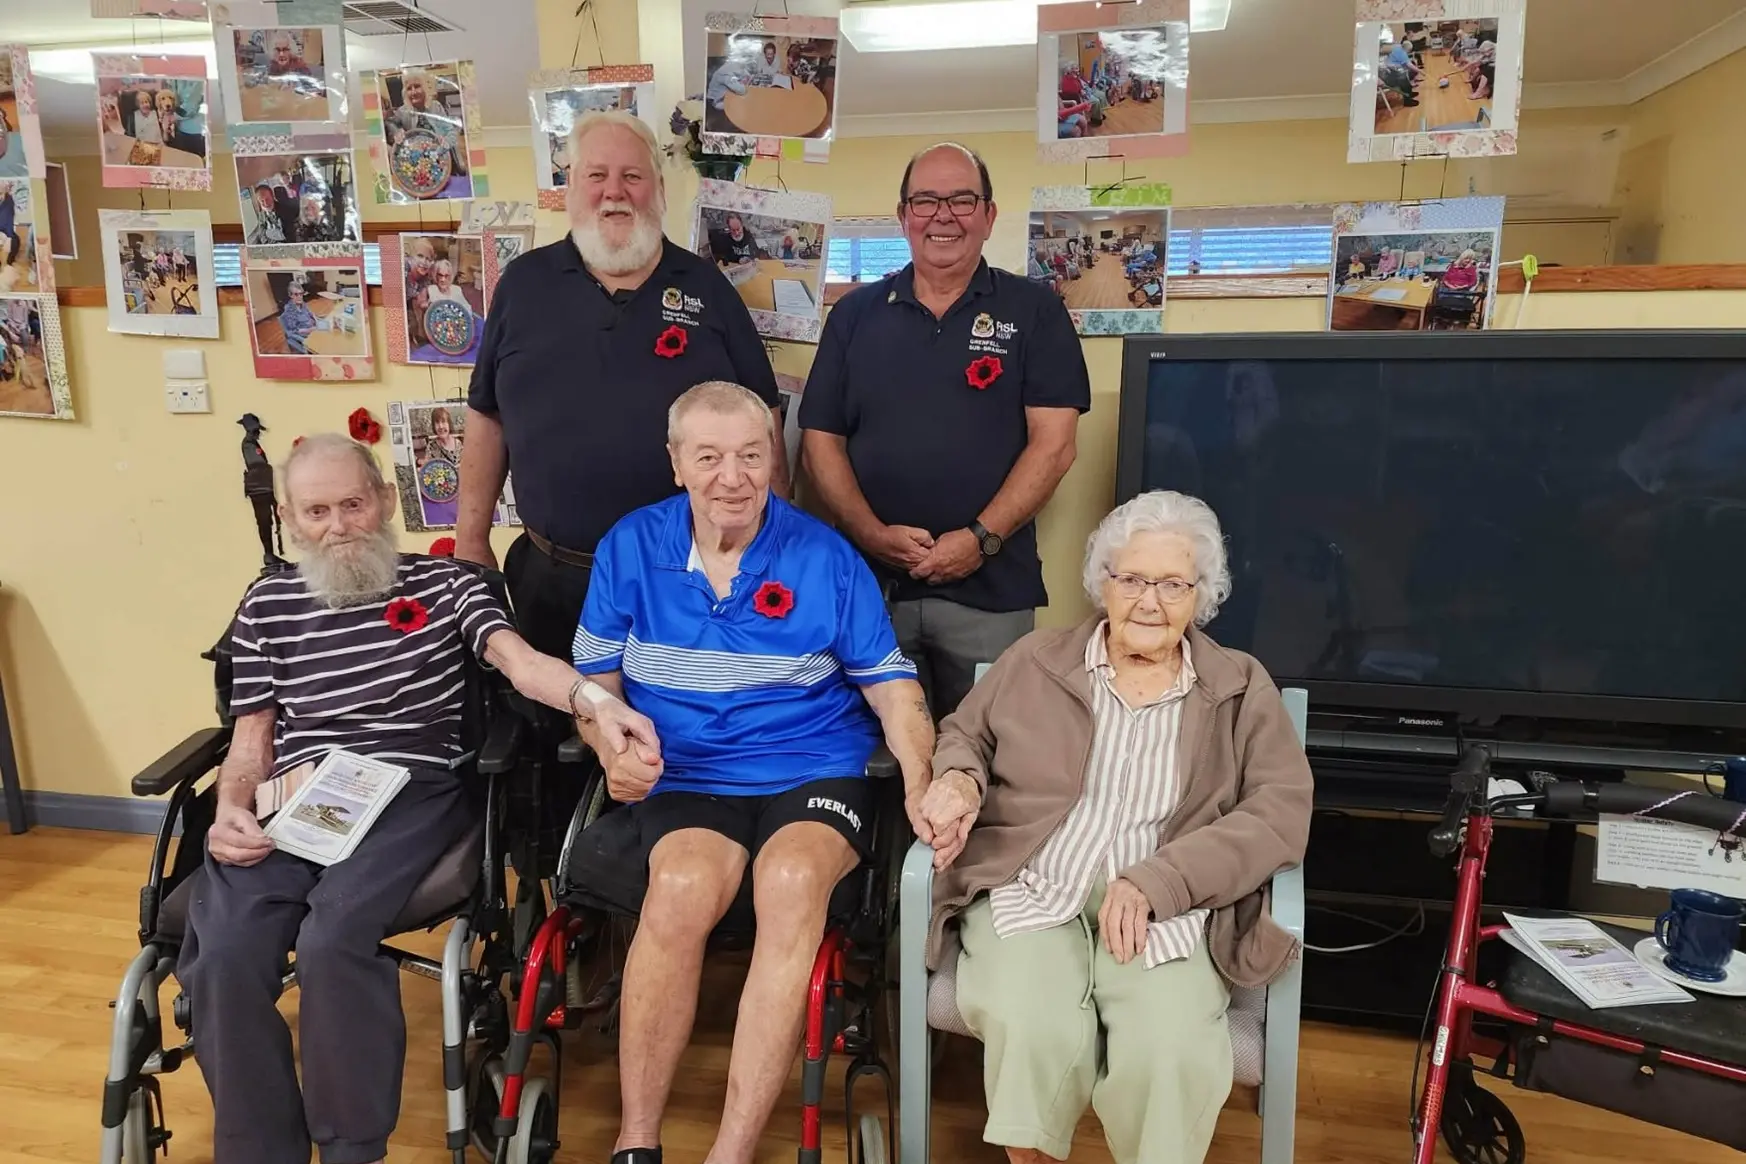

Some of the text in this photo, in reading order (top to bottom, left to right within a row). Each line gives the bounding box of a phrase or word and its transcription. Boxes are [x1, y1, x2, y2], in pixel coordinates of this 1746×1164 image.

[684, 294, 705, 308] RSL
[996, 321, 1018, 332] RSL
[969, 338, 1001, 348] GRENFELL
[1398, 716, 1444, 726] Panasonic
